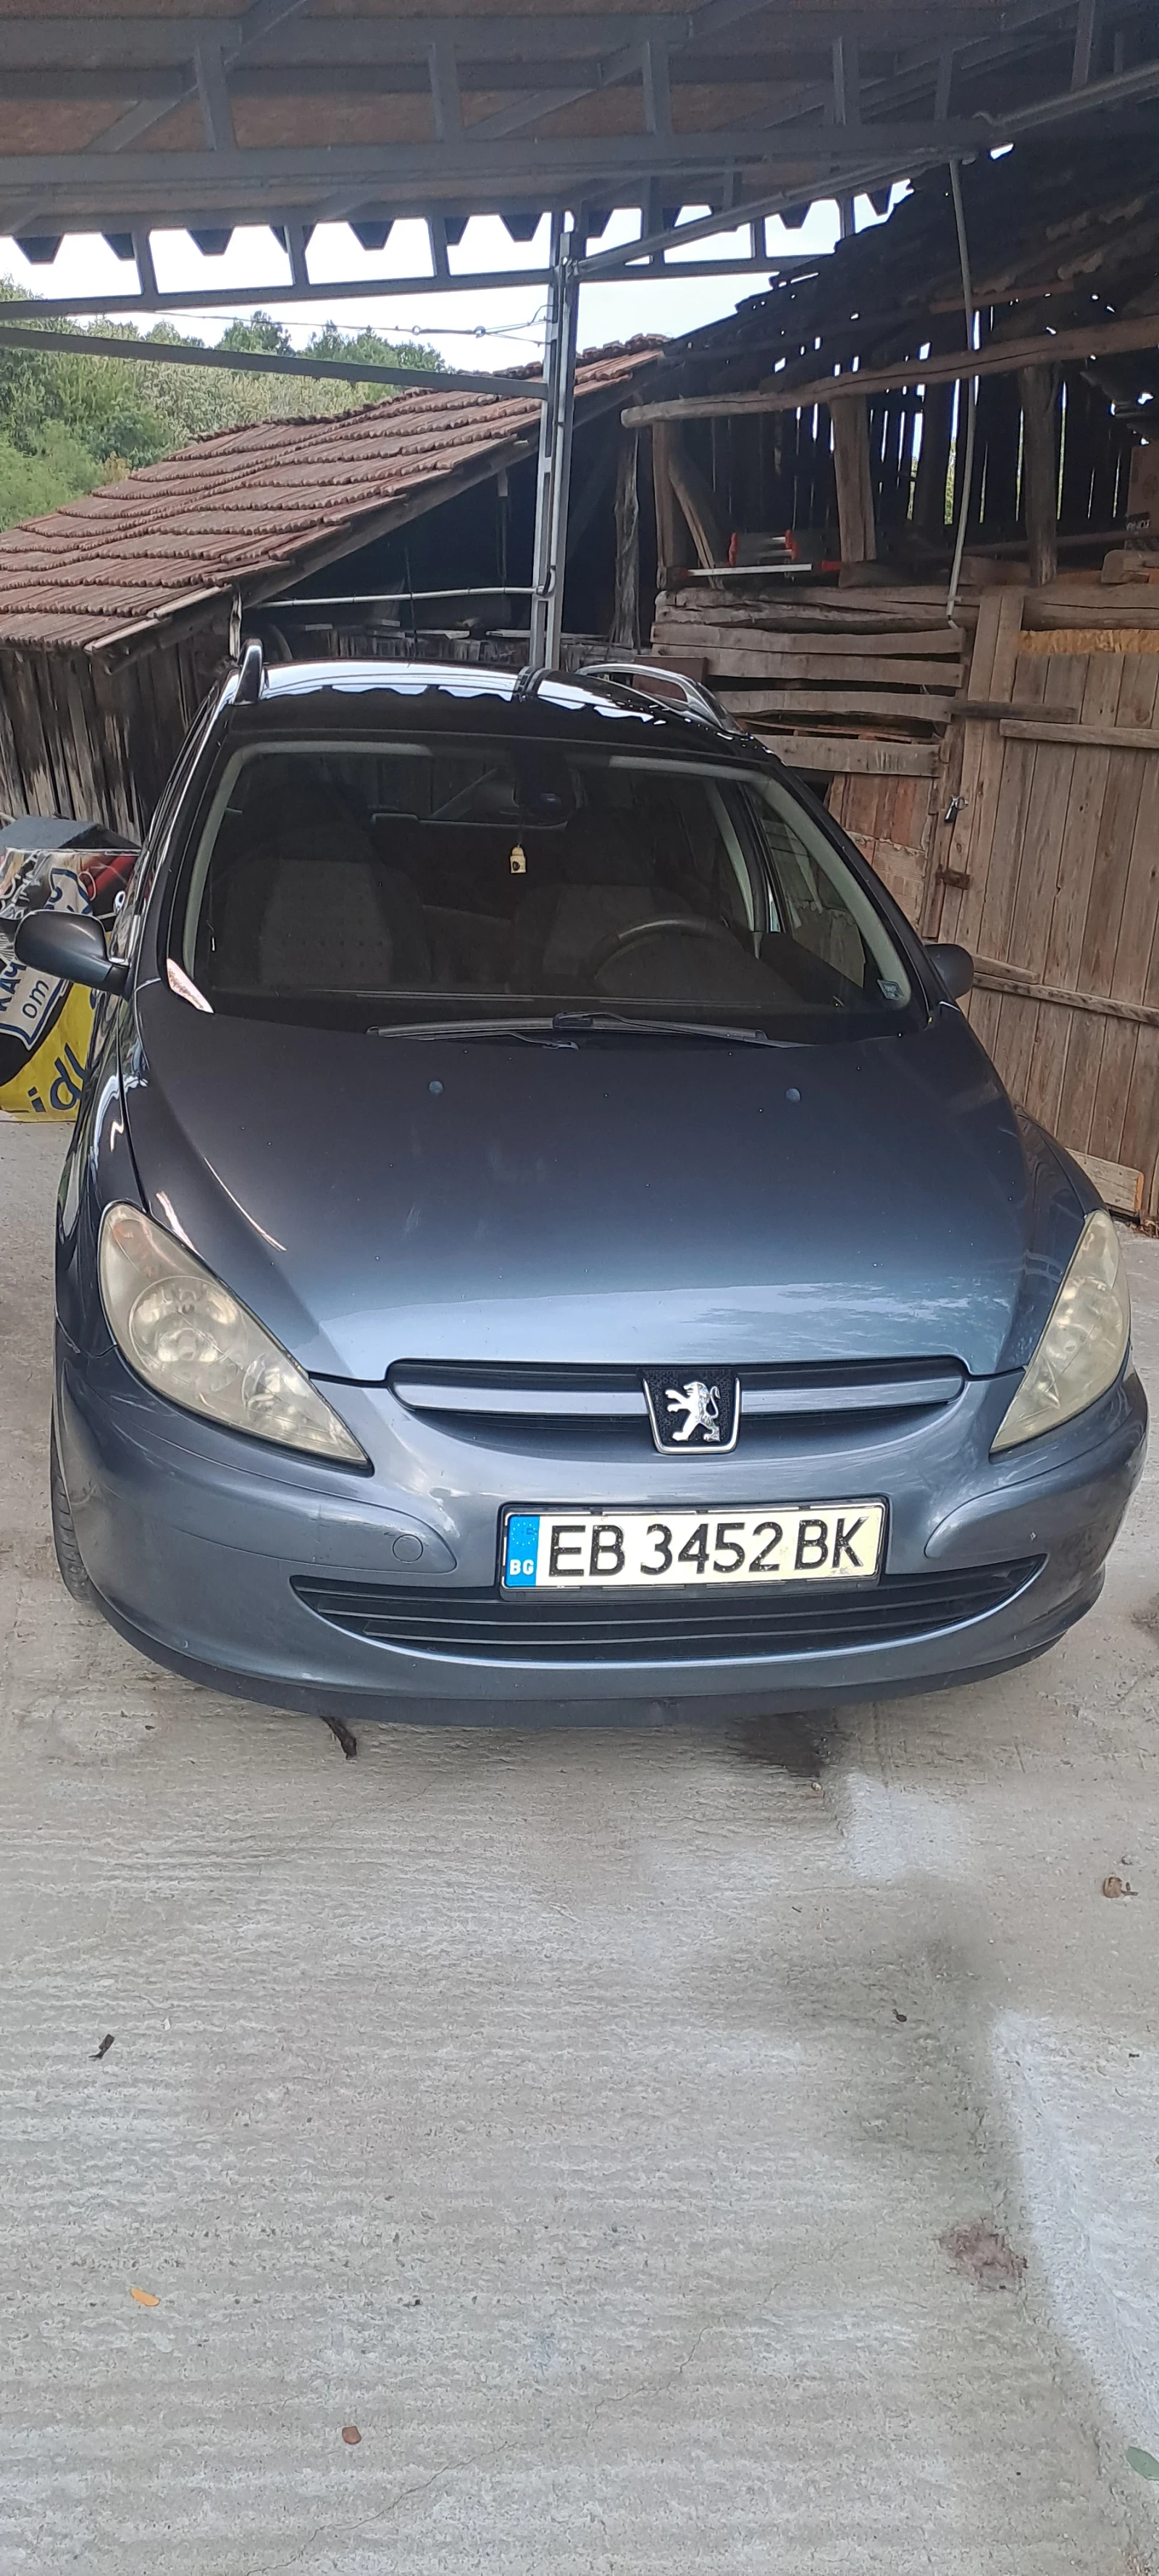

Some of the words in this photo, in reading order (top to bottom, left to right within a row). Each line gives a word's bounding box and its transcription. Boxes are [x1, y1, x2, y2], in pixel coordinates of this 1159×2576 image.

[548, 1525, 626, 1577] EB
[640, 1521, 784, 1576] 3452
[794, 1516, 869, 1571] BK
[509, 1559, 535, 1576] BG
